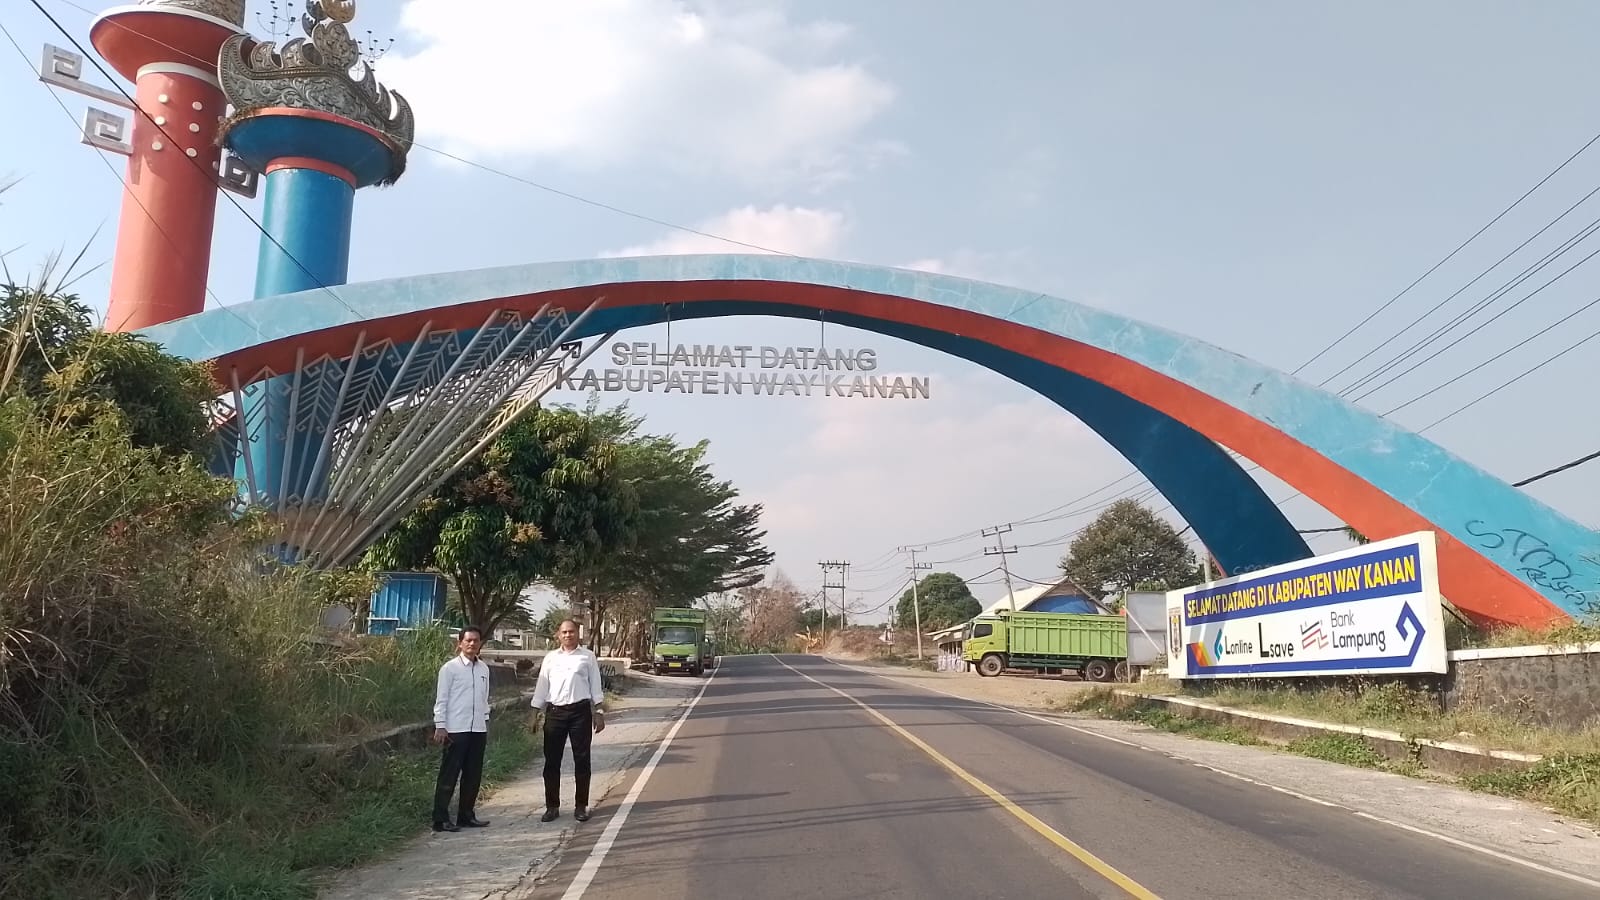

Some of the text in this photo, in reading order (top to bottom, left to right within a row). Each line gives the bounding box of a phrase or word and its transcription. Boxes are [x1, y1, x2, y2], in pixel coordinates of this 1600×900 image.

[611, 342, 877, 371] SELAMAT DATANG
[555, 367, 930, 399] KABUPATEN WAY KANAN
[1187, 555, 1416, 618] SELAMAT DATANG DI KABUPATEN WAY KANAN
[1330, 609, 1355, 628] Bank
[1332, 630, 1386, 652] Lampung
